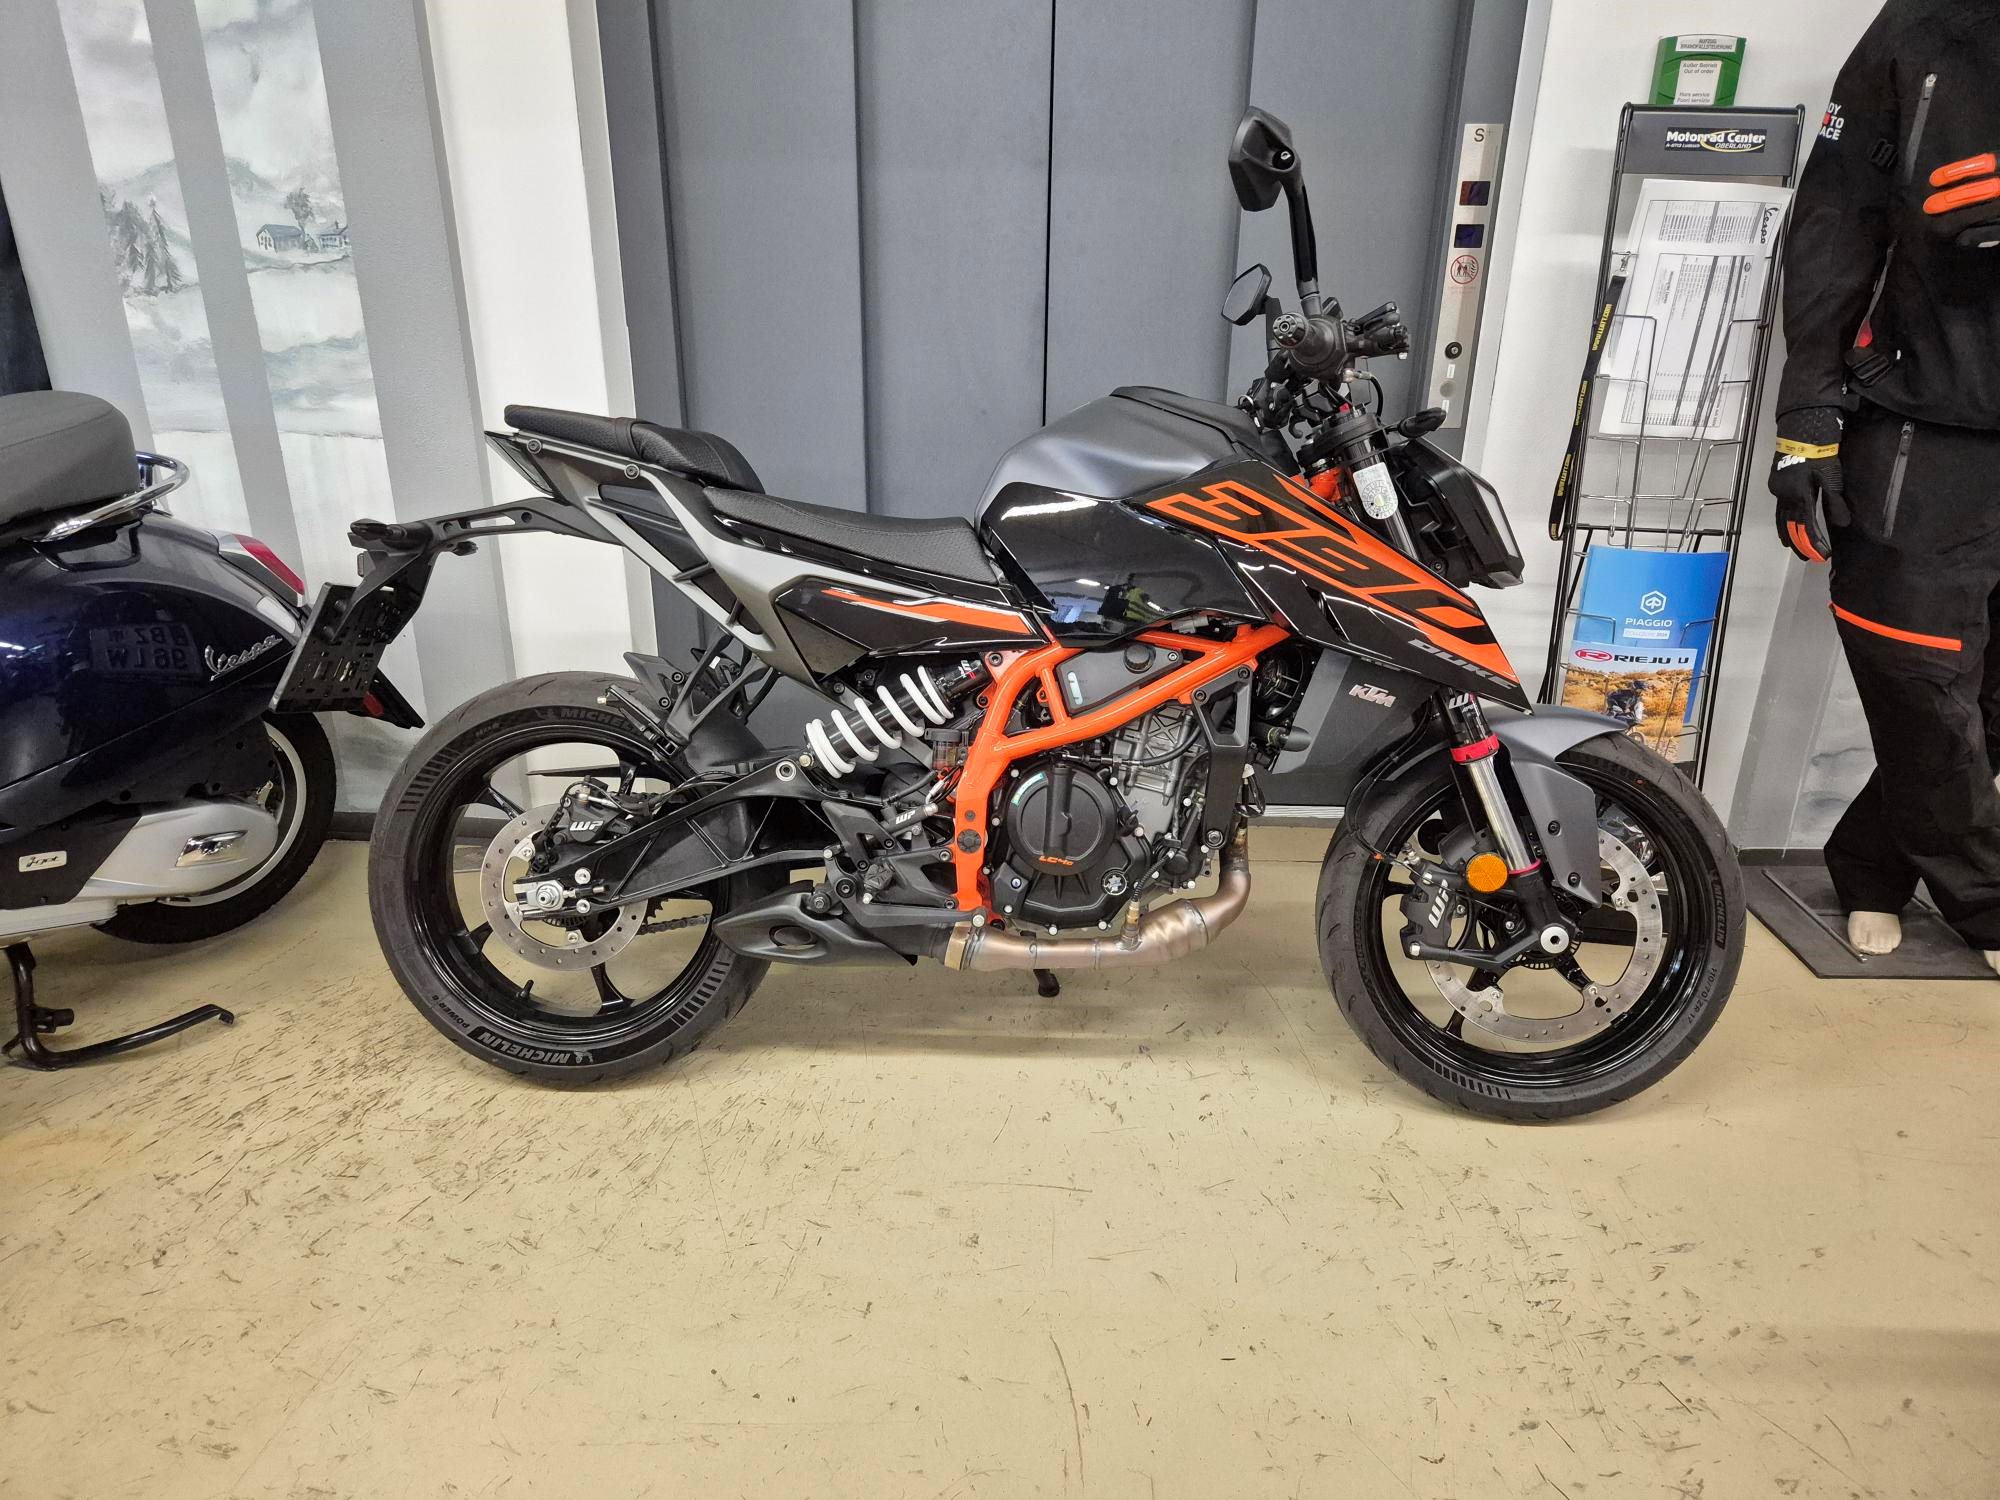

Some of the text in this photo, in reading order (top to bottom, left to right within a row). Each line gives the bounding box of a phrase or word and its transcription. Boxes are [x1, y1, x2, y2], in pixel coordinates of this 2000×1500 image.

[1666, 131, 1766, 144] Motorrad Center
[1625, 617, 1673, 628] PIAGGIO
[205, 634, 283, 682] Vespa
[1407, 638, 1518, 690] DUKE
[1613, 654, 1671, 664] RIEJU
[1349, 683, 1396, 708] KTM
[570, 820, 604, 831] WP
[1714, 881, 1726, 945] MICHELIN
[438, 1001, 470, 1029] POWER
[477, 1031, 571, 1064] MICHELIN
